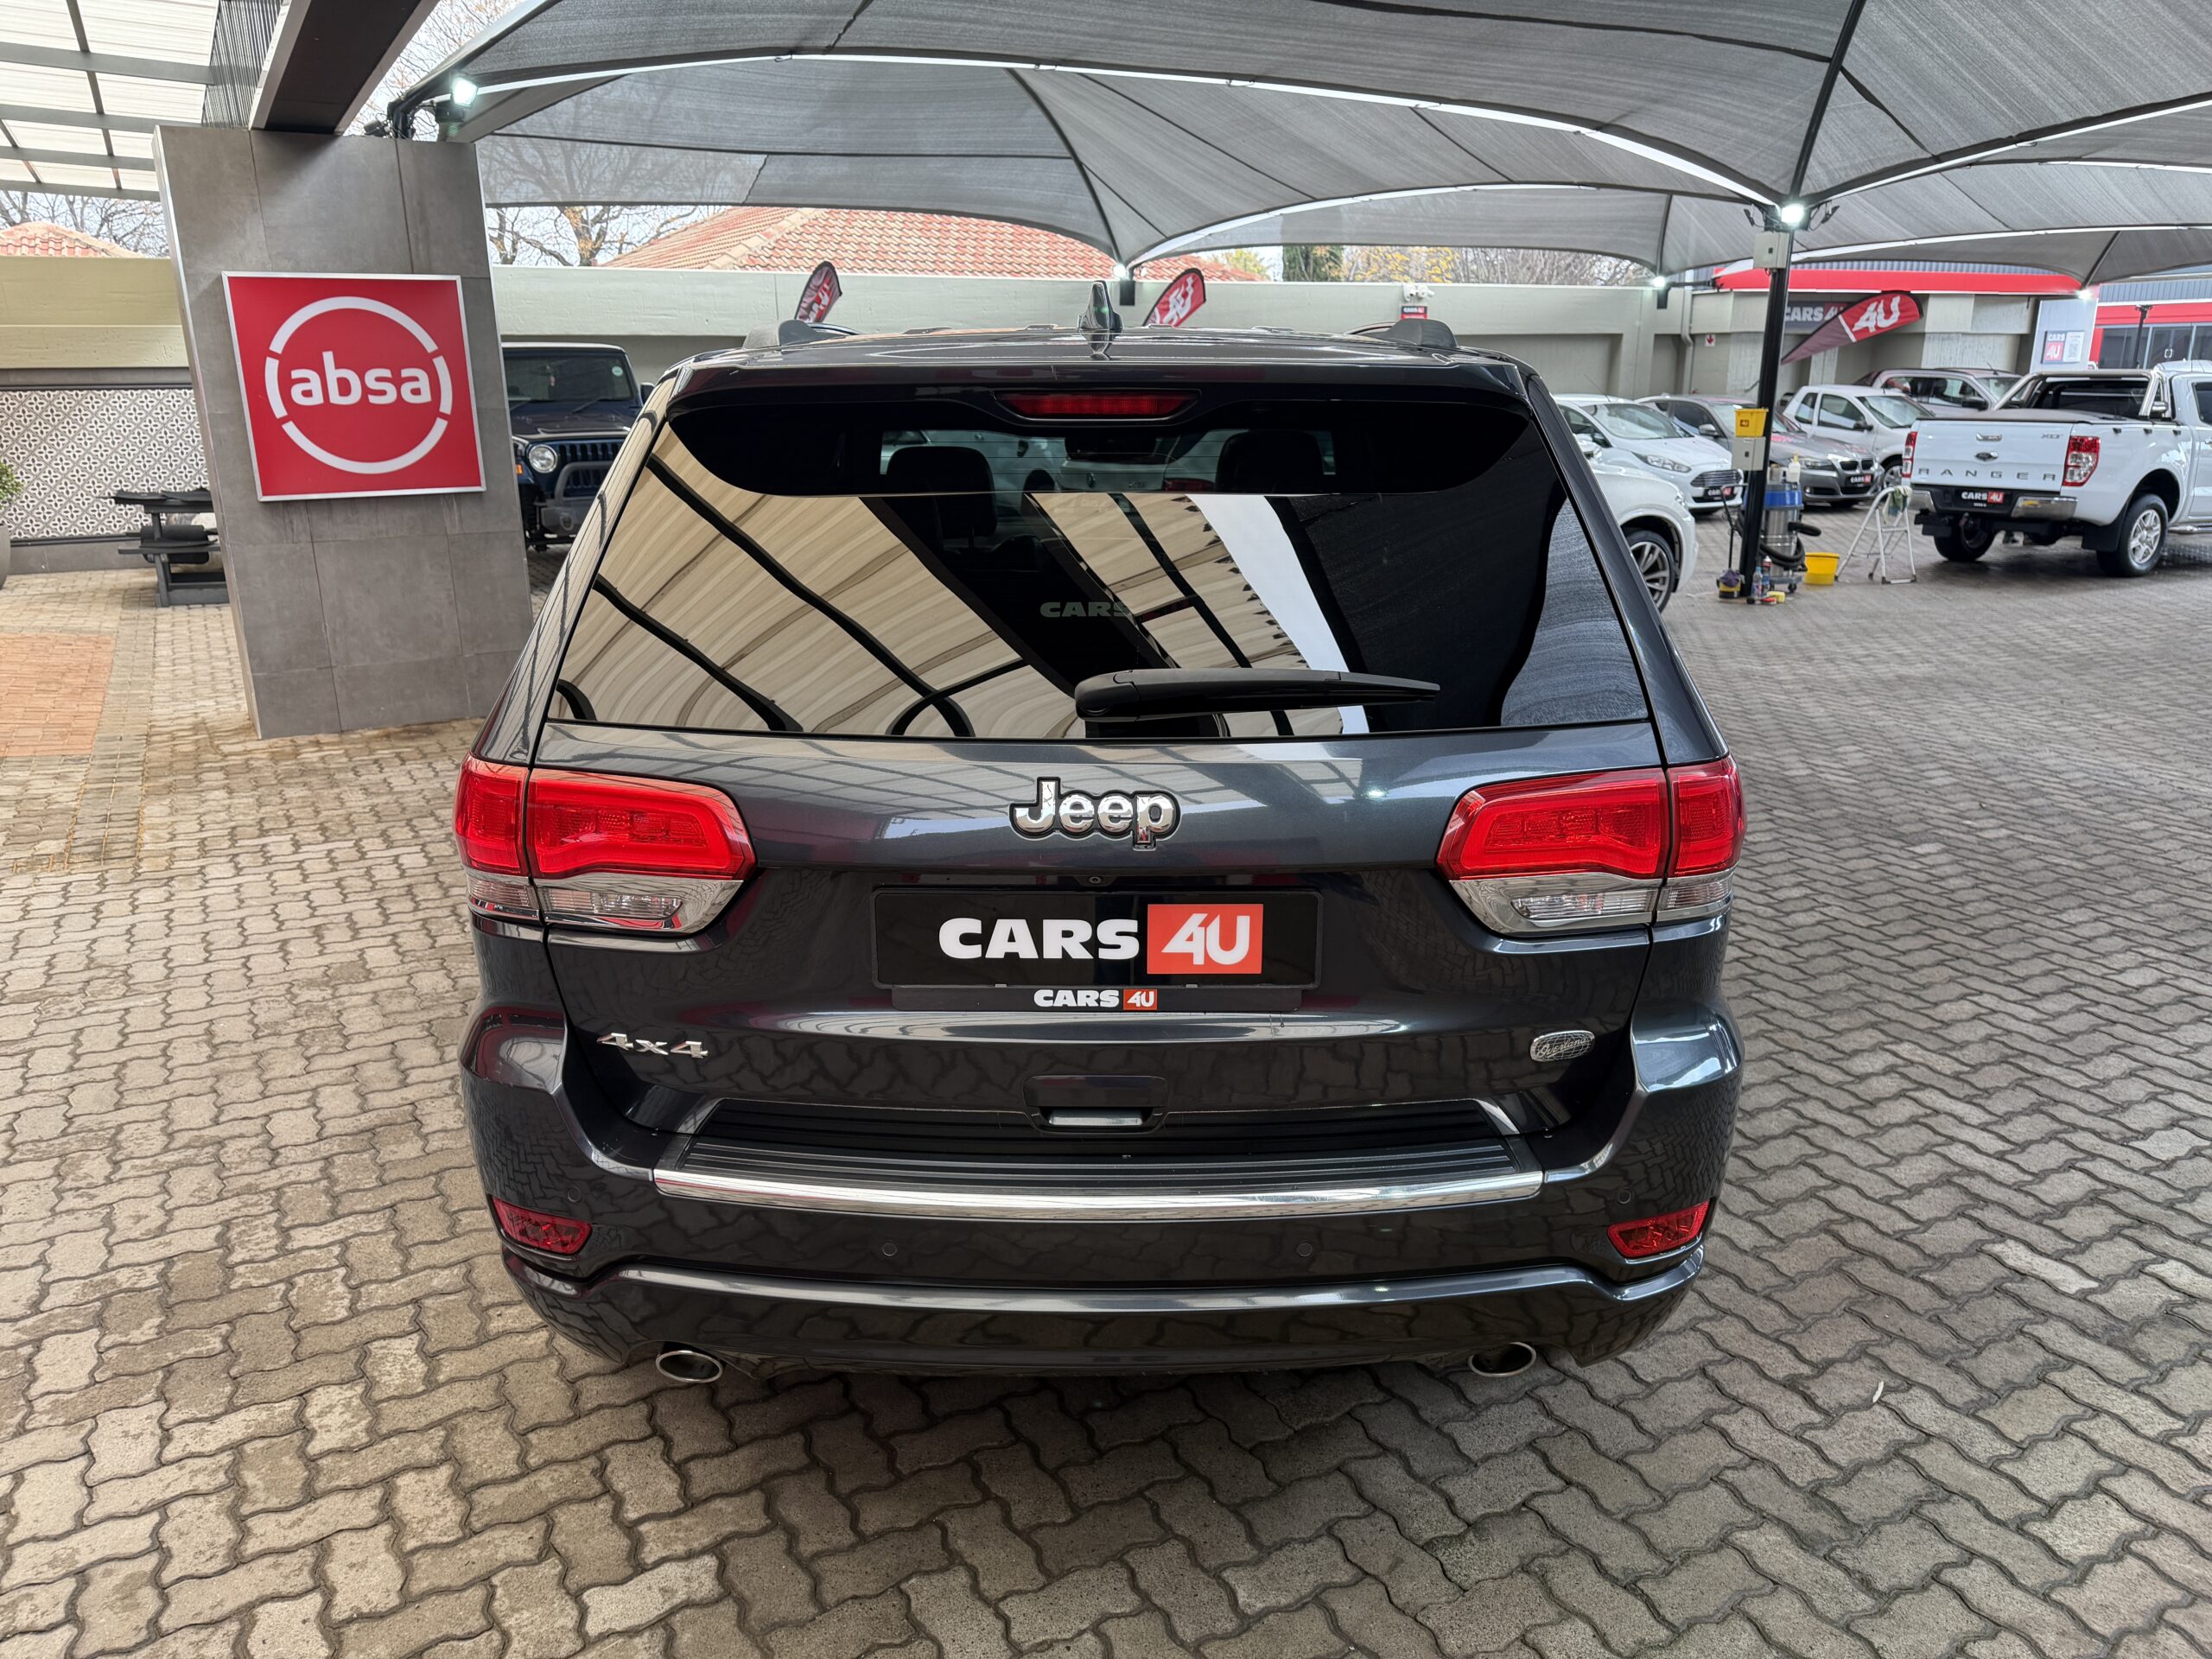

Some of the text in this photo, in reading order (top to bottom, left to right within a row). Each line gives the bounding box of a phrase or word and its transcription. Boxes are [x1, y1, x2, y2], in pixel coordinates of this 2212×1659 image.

[1852, 296, 1901, 333] 4U
[2046, 345, 2061, 359] 4U
[290, 350, 432, 406] absa
[1918, 467, 2056, 481] RANGER
[1961, 491, 2005, 503] CARS 4U
[1014, 779, 1176, 846] Jeep
[938, 912, 1251, 966] CARS 4U
[1033, 989, 1155, 1008] CARS 4U
[596, 1033, 709, 1058] 4x4
[1537, 1037, 1588, 1058] Overland
